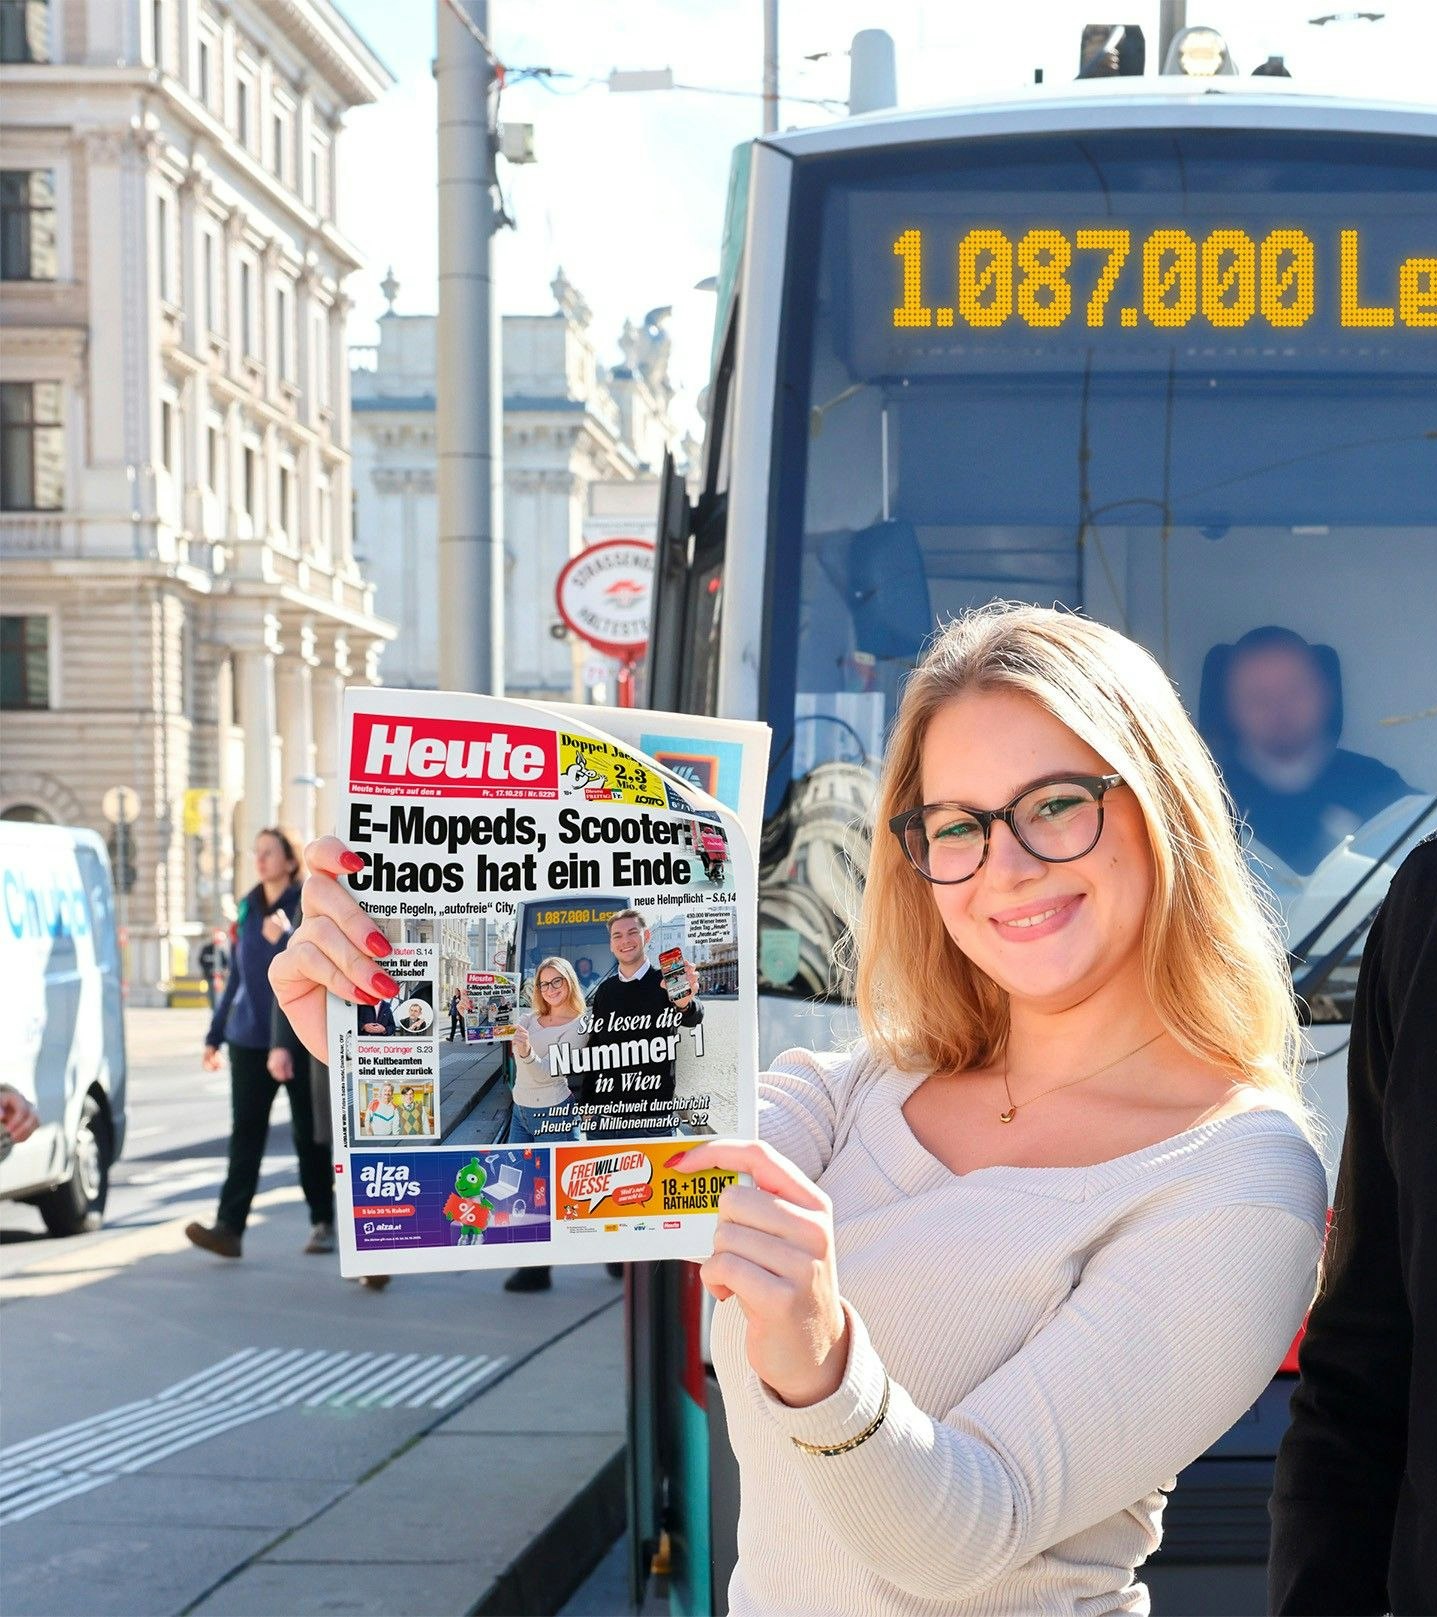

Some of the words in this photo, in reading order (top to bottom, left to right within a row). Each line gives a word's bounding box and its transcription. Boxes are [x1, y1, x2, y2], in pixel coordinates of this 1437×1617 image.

[893, 229, 1315, 328] 1.087.000
[364, 723, 546, 782] Heute
[561, 734, 607, 754] Doppel
[614, 764, 647, 783] 2,3
[352, 785, 373, 793] Heute
[406, 787, 420, 796] auf
[421, 788, 435, 796] den
[635, 795, 665, 806] LOTTO
[349, 803, 547, 854] E-Mopeds,
[558, 808, 692, 846] Scooter:
[348, 851, 464, 893] Chaos
[477, 854, 537, 892] hat
[548, 852, 600, 890] ein
[612, 852, 691, 887] Ende
[358, 901, 397, 917] Strenge
[400, 902, 437, 916] Regeln,
[495, 901, 517, 915] City,
[634, 896, 655, 906] neue
[657, 893, 703, 906] Helmpflicht
[400, 958, 411, 967] für
[413, 958, 428, 967] den
[577, 1013, 603, 1035] Sie
[607, 1011, 652, 1033] lesen
[655, 1008, 682, 1028] die
[416, 1045, 433, 1053] S.23
[549, 1032, 681, 1077] Nummer
[690, 1023, 704, 1057] 1
[358, 1057, 371, 1065] Die
[373, 1056, 422, 1066] Kultbeamten
[358, 1067, 376, 1075] sind
[378, 1067, 404, 1075] wieder
[405, 1067, 433, 1075] zurück
[595, 1073, 615, 1093] in
[621, 1072, 661, 1092] Wien
[549, 1105, 570, 1117] und
[571, 1100, 648, 1116] österreichweit
[650, 1096, 710, 1112] durchbricht
[534, 1120, 579, 1136] „Heute“
[580, 1118, 597, 1132] die
[599, 1114, 680, 1131] Millionenmarke
[690, 1113, 708, 1126] S.2
[359, 1162, 410, 1182] alza
[570, 1153, 645, 1181] FREIWILLIGEN
[365, 1179, 421, 1201] days
[567, 1174, 612, 1198] MESSE
[663, 1195, 708, 1210] RATHAUS
